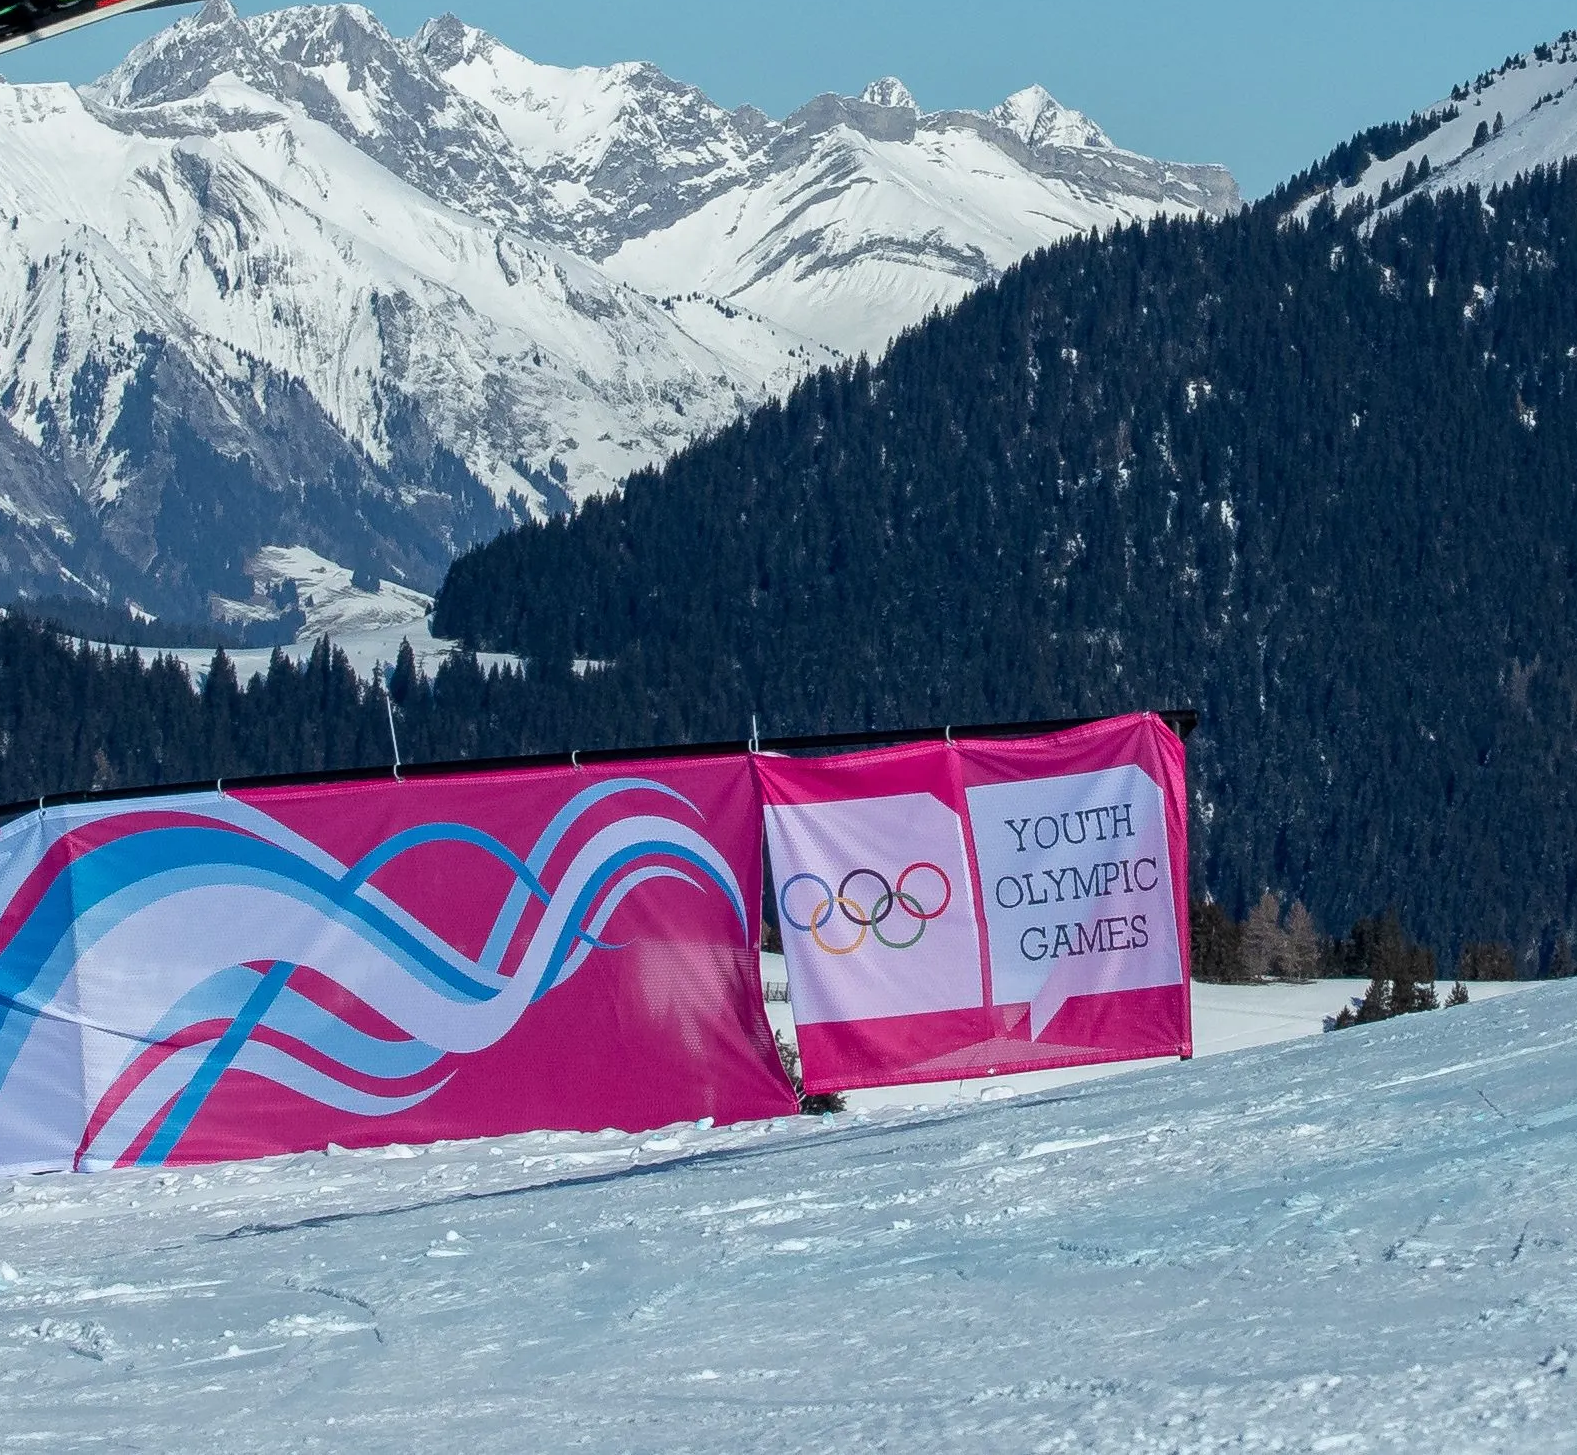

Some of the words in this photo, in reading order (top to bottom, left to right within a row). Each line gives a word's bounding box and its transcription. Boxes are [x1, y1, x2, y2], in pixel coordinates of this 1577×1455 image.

[1005, 803, 1136, 853] YOUTH
[995, 857, 1158, 910] OLYMPIC
[1020, 914, 1149, 961] GAMES
